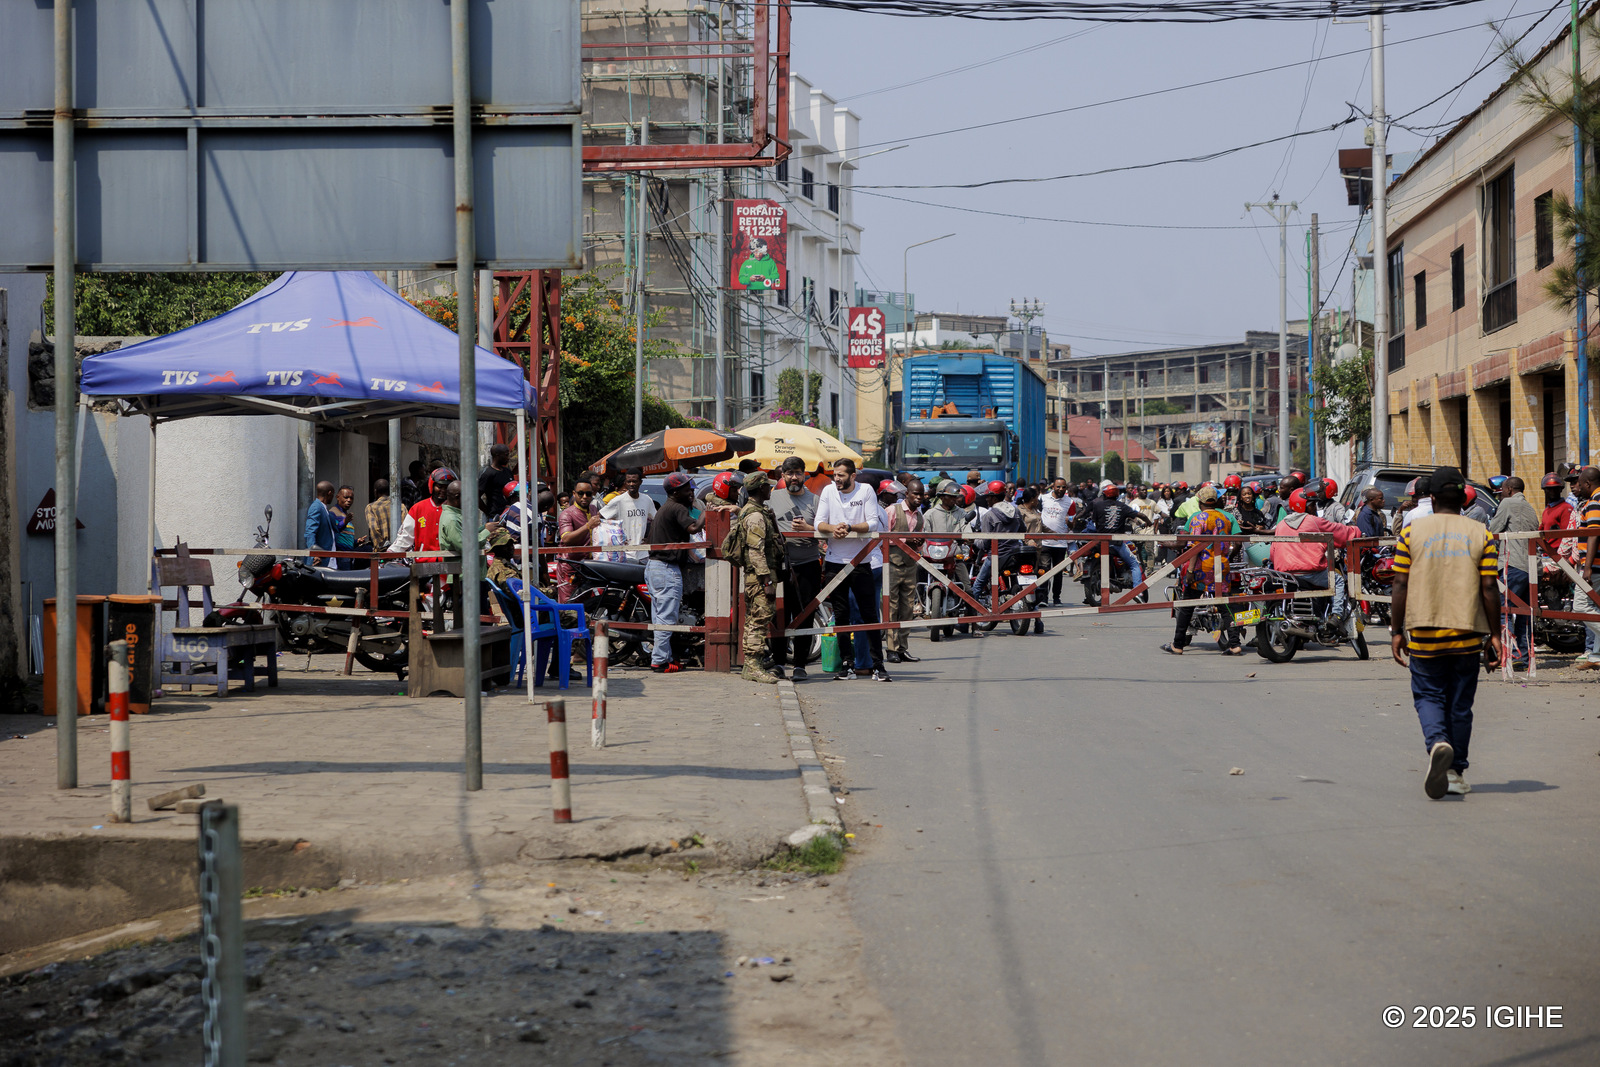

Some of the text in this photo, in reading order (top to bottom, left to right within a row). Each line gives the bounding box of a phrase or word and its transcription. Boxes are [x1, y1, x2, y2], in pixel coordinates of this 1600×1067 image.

[736, 206, 784, 216] FORFAITS
[739, 216, 782, 226] RETRAIT
[246, 317, 312, 334] TVS
[850, 309, 882, 339] 4$
[850, 338, 883, 346] FORFAITS
[850, 345, 883, 356] MOIS
[162, 370, 199, 386] TVS
[266, 370, 303, 386] TVS
[370, 378, 407, 392] TVS
[677, 443, 714, 455] Orange
[36, 507, 57, 518] STO
[627, 509, 646, 518] DIOR
[35, 519, 57, 530] MO
[172, 636, 209, 656] tigo
